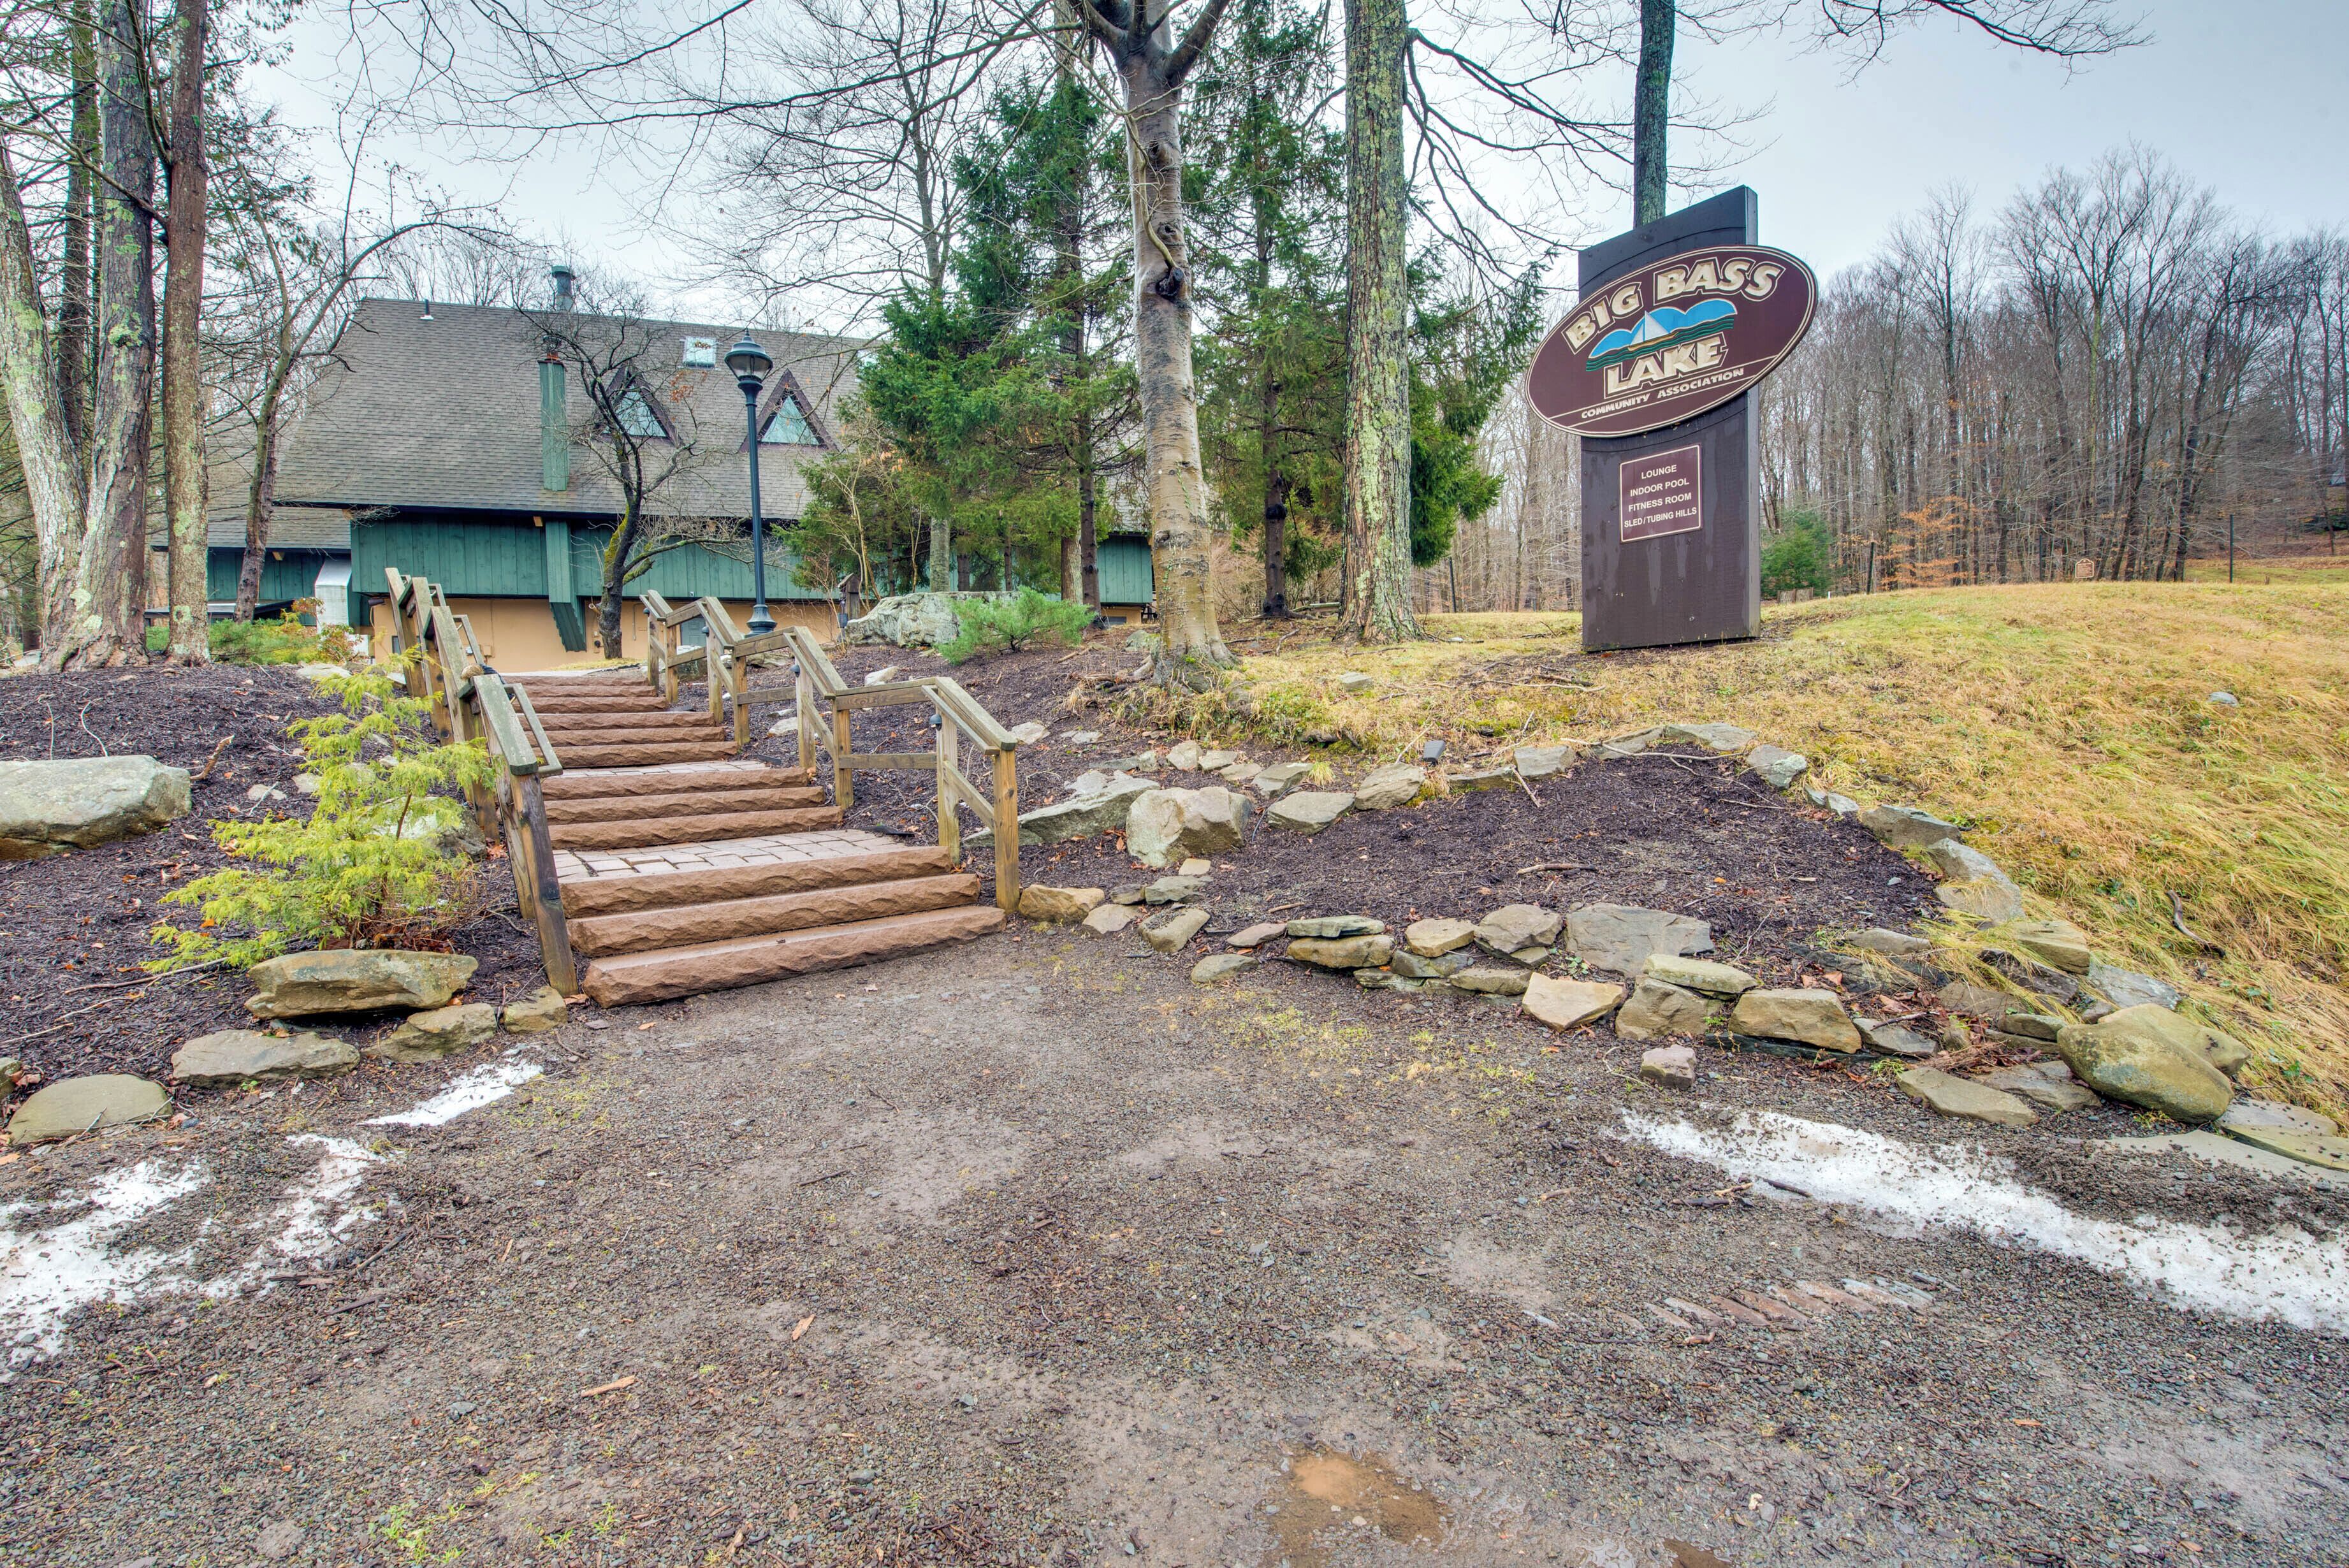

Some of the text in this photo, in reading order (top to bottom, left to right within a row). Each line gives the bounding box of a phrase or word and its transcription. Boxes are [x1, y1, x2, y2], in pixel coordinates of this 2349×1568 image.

[1564, 259, 1782, 350] BIG BASS
[1607, 336, 1722, 395] LAKE
[1581, 367, 1745, 419] COMMUNITY ASSOCIATION
[1641, 464, 1677, 479] LOUNGE
[1630, 477, 1689, 497] INDOOR POOL
[1628, 492, 1692, 512] FITNESS ROOM
[1675, 507, 1698, 518] HILLS
